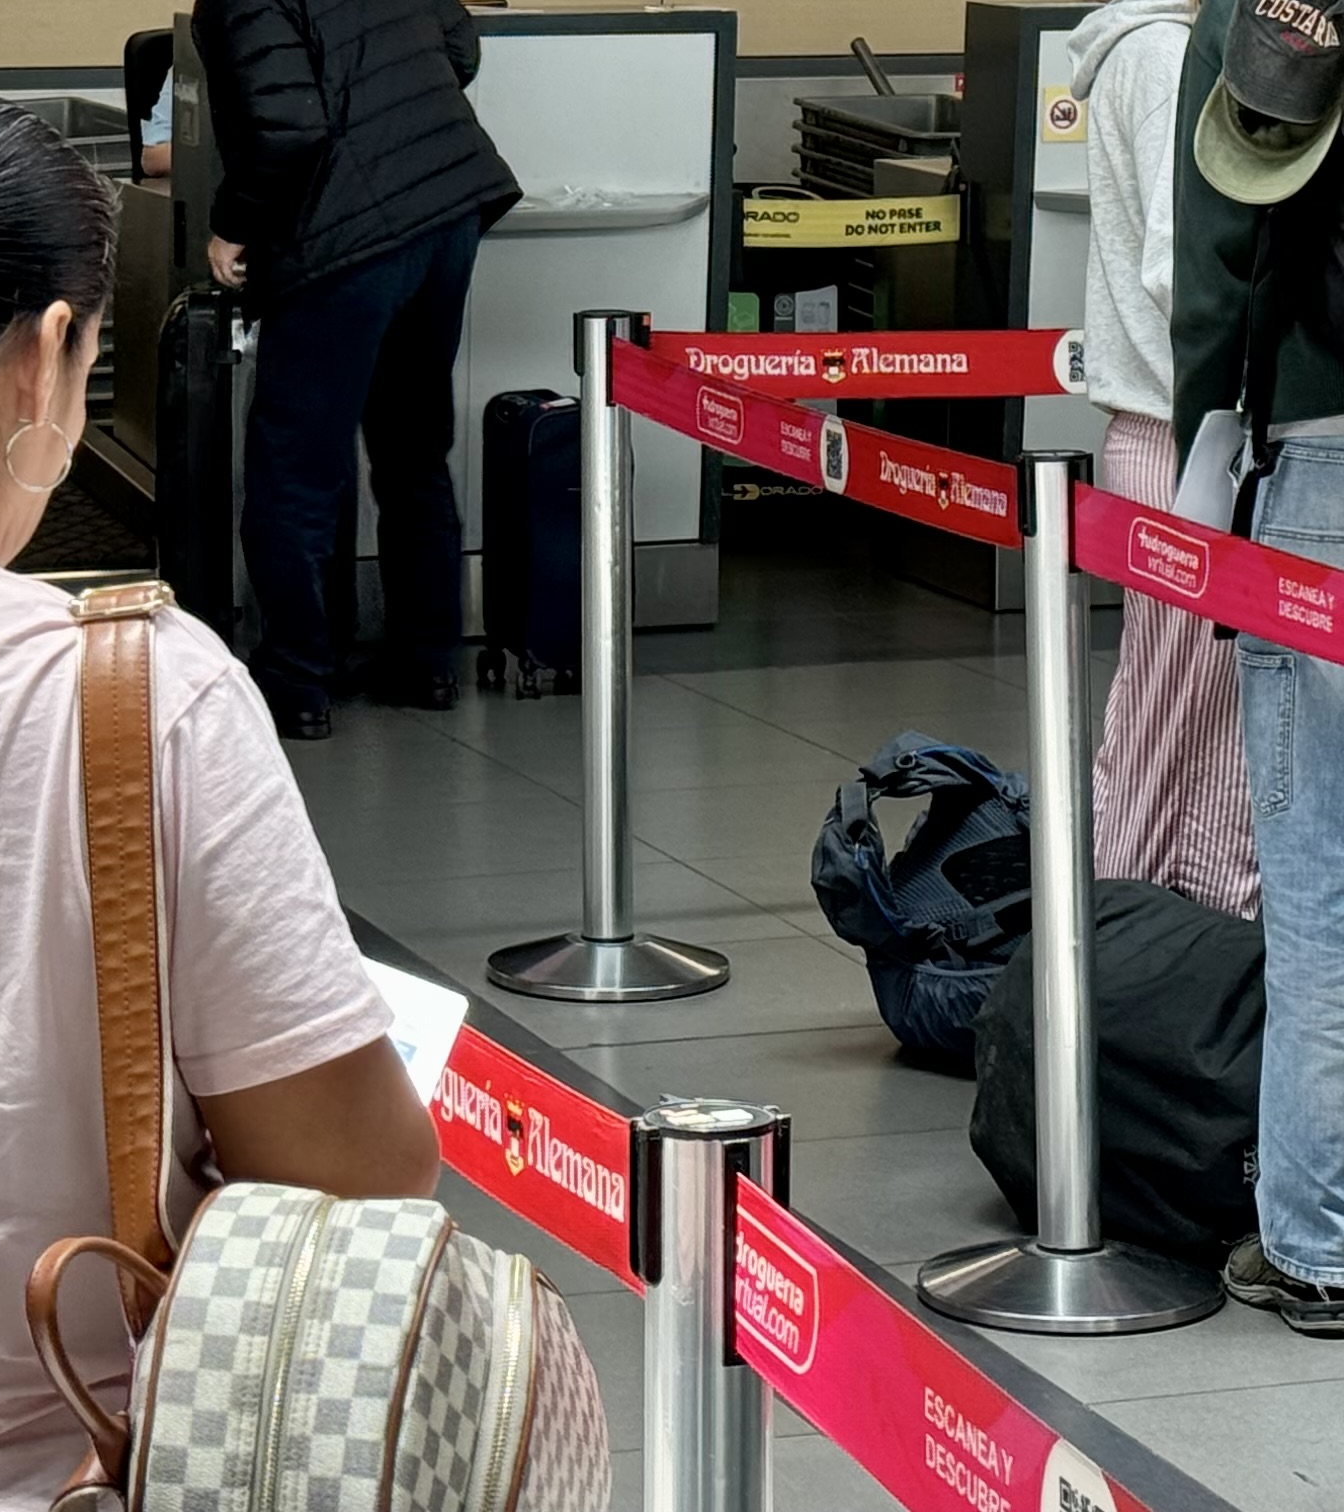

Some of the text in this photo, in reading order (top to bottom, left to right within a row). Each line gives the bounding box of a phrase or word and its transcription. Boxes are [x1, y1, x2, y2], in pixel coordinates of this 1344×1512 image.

[745, 210, 800, 223] RADO
[845, 221, 942, 236] DO NOT ENTER
[865, 208, 886, 221] NO
[685, 347, 968, 380] Droguería Alemana
[1278, 577, 1335, 611] ESCANEA Y
[1278, 600, 1334, 633] DESCUBRE
[528, 1107, 625, 1223] Alemana
[925, 1386, 1013, 1486] ESCANEA Y
